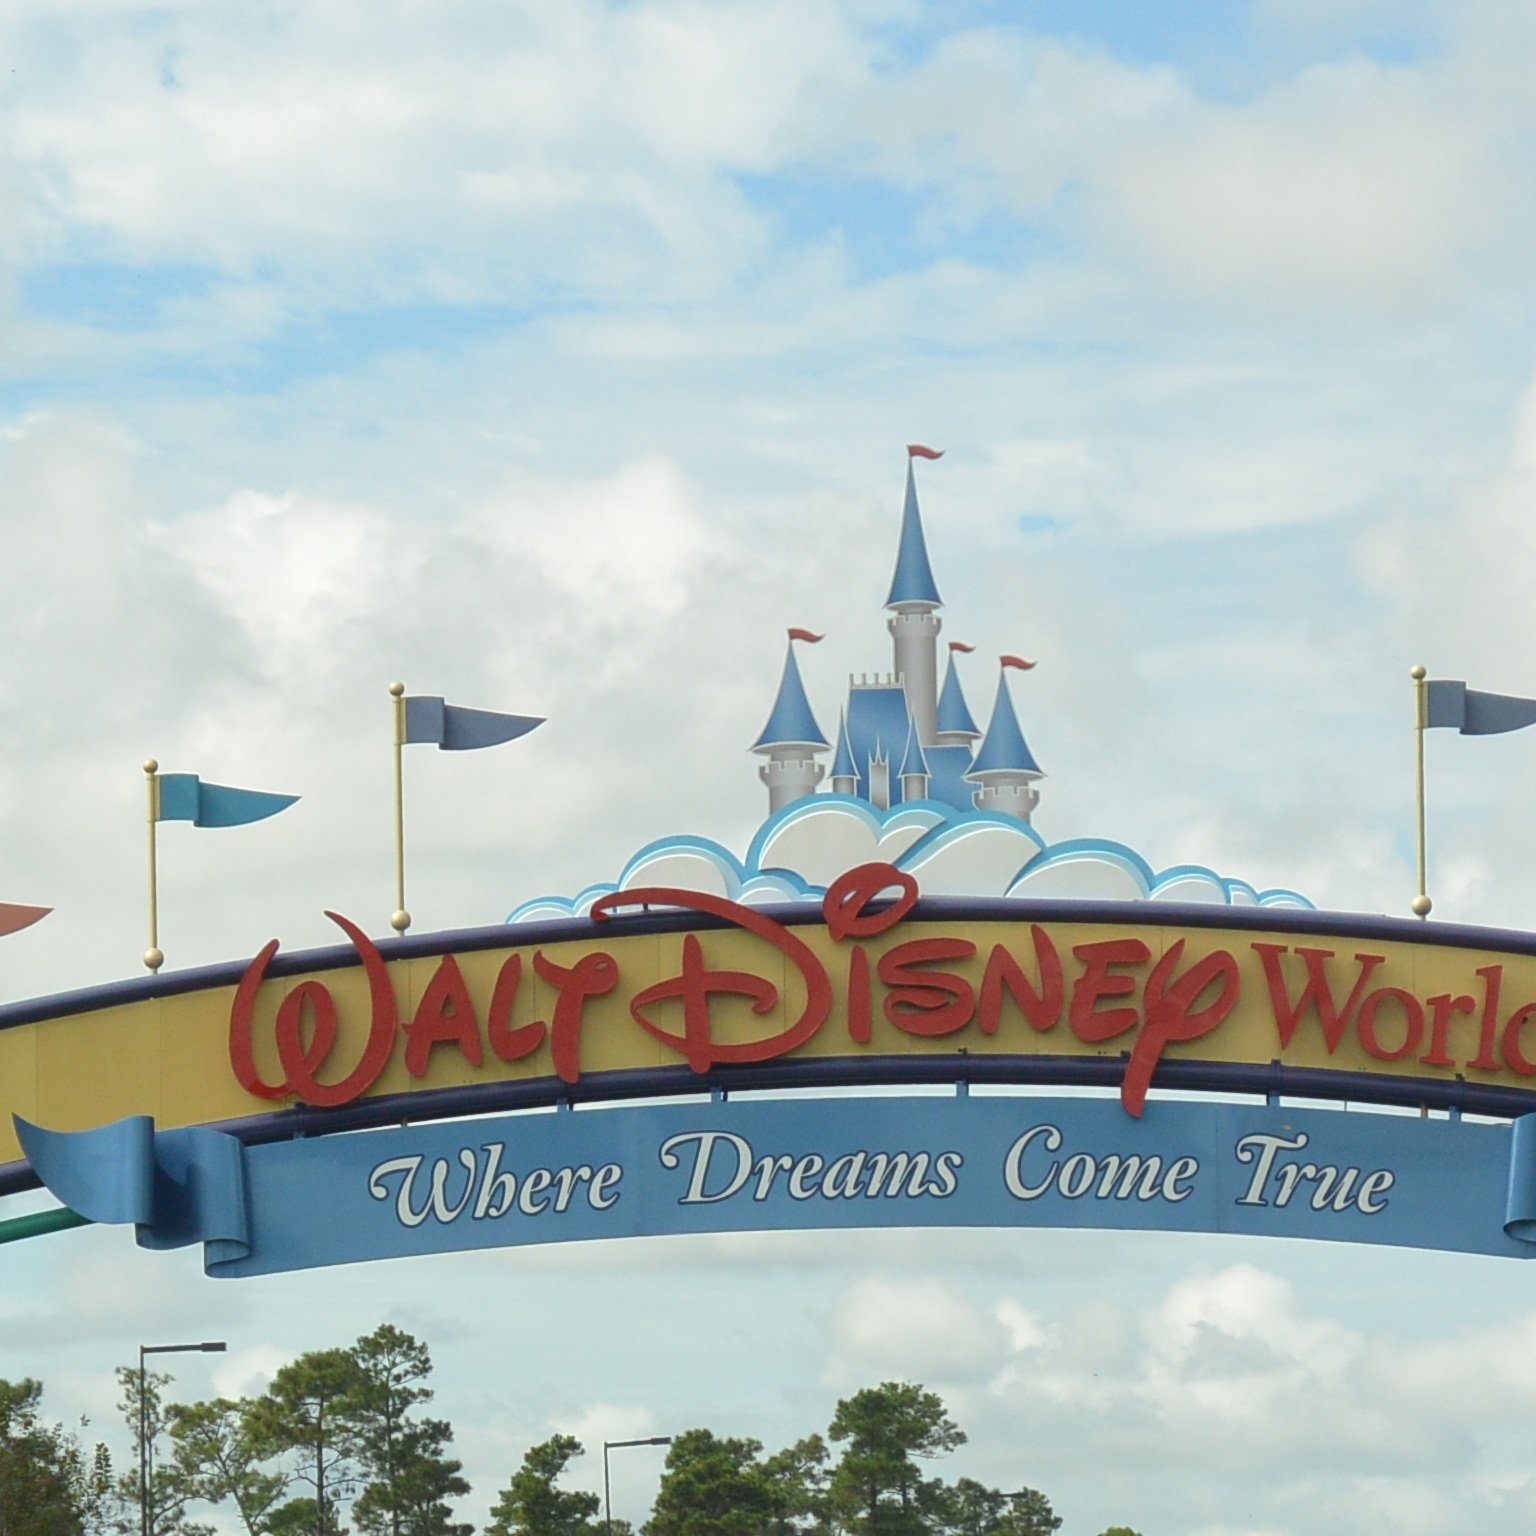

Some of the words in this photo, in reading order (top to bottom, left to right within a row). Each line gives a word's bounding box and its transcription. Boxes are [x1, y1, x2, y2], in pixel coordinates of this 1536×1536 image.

[369, 1141, 624, 1228] Where
[658, 1130, 965, 1205] Dreams
[1004, 1124, 1199, 1202] Come
[1235, 1132, 1396, 1214] True
